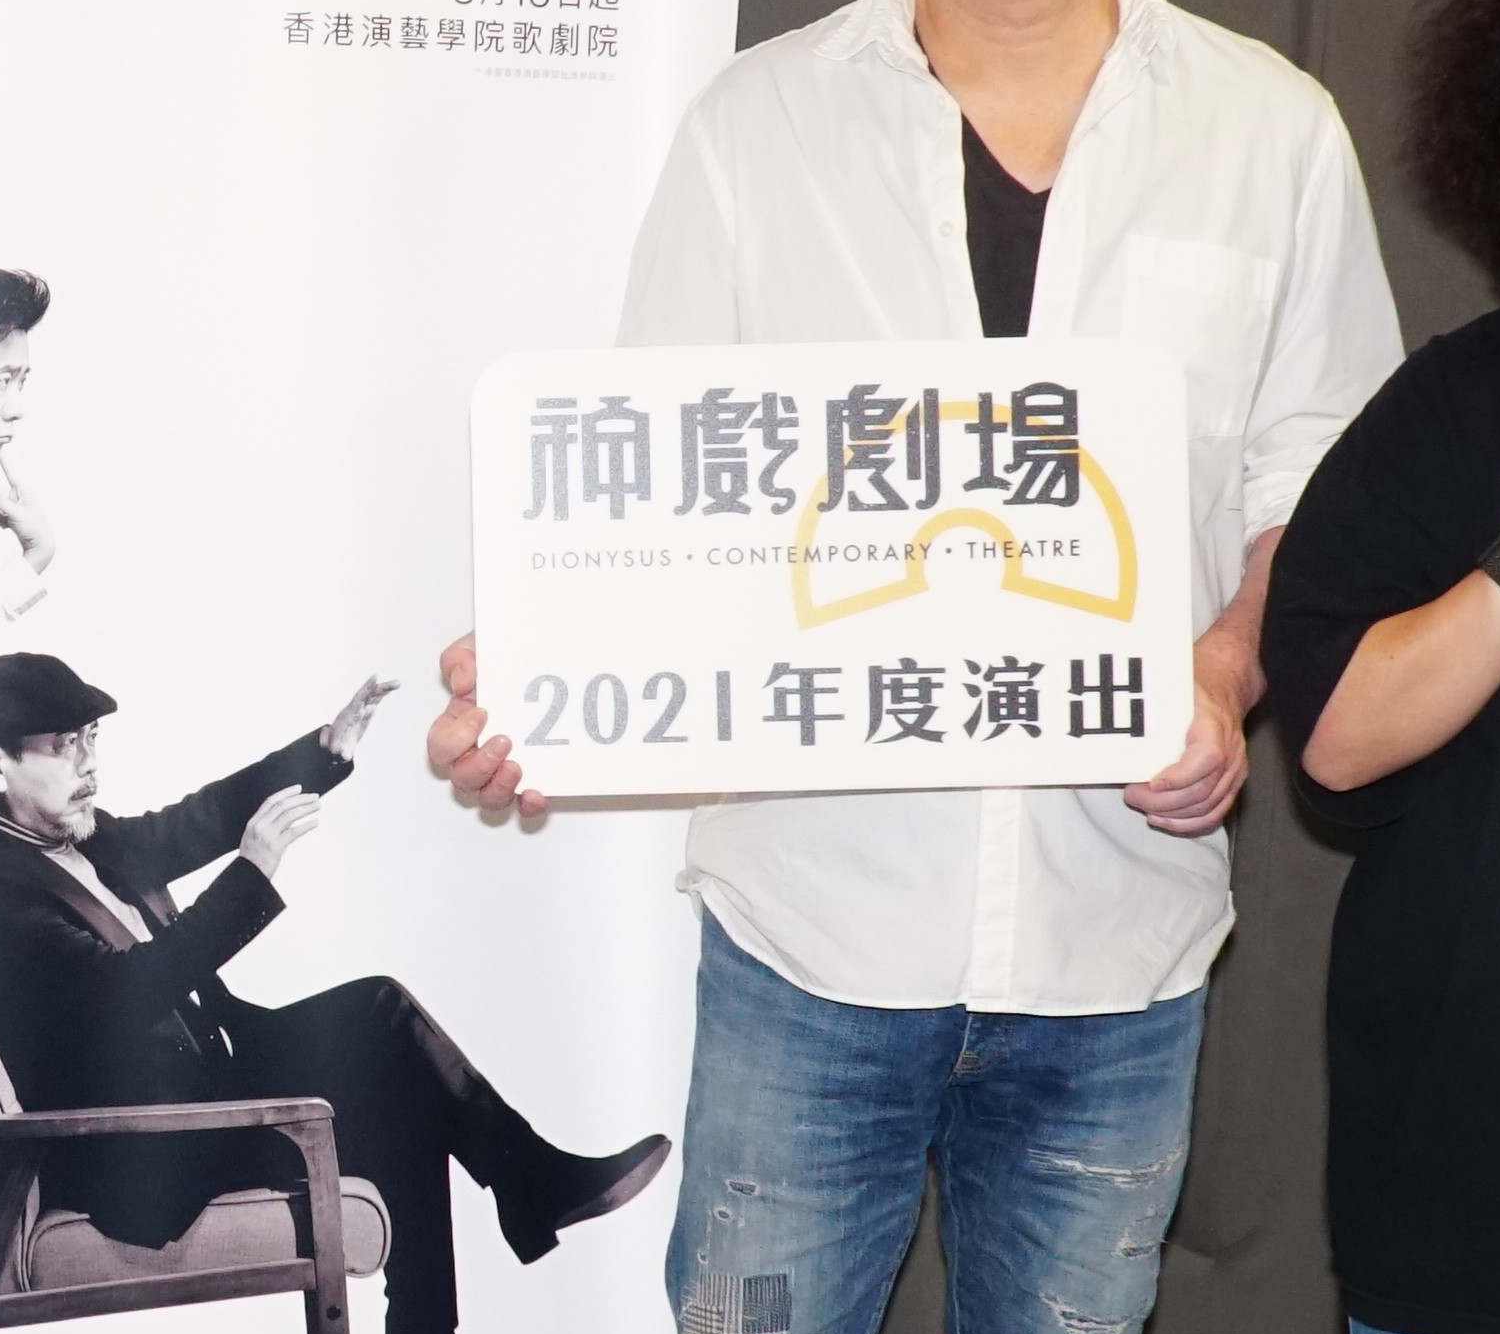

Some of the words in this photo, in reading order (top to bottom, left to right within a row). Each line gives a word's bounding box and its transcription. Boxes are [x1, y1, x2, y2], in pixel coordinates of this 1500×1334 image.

[283, 11, 619, 58] 香港演藝學院歌劇院
[521, 380, 1082, 523] 神戲劇場
[531, 549, 672, 570] DIONYSUS
[706, 541, 934, 566] CONTEMPORARY
[966, 538, 1082, 560] THEATRE
[522, 653, 1146, 748] 2021年度演出
